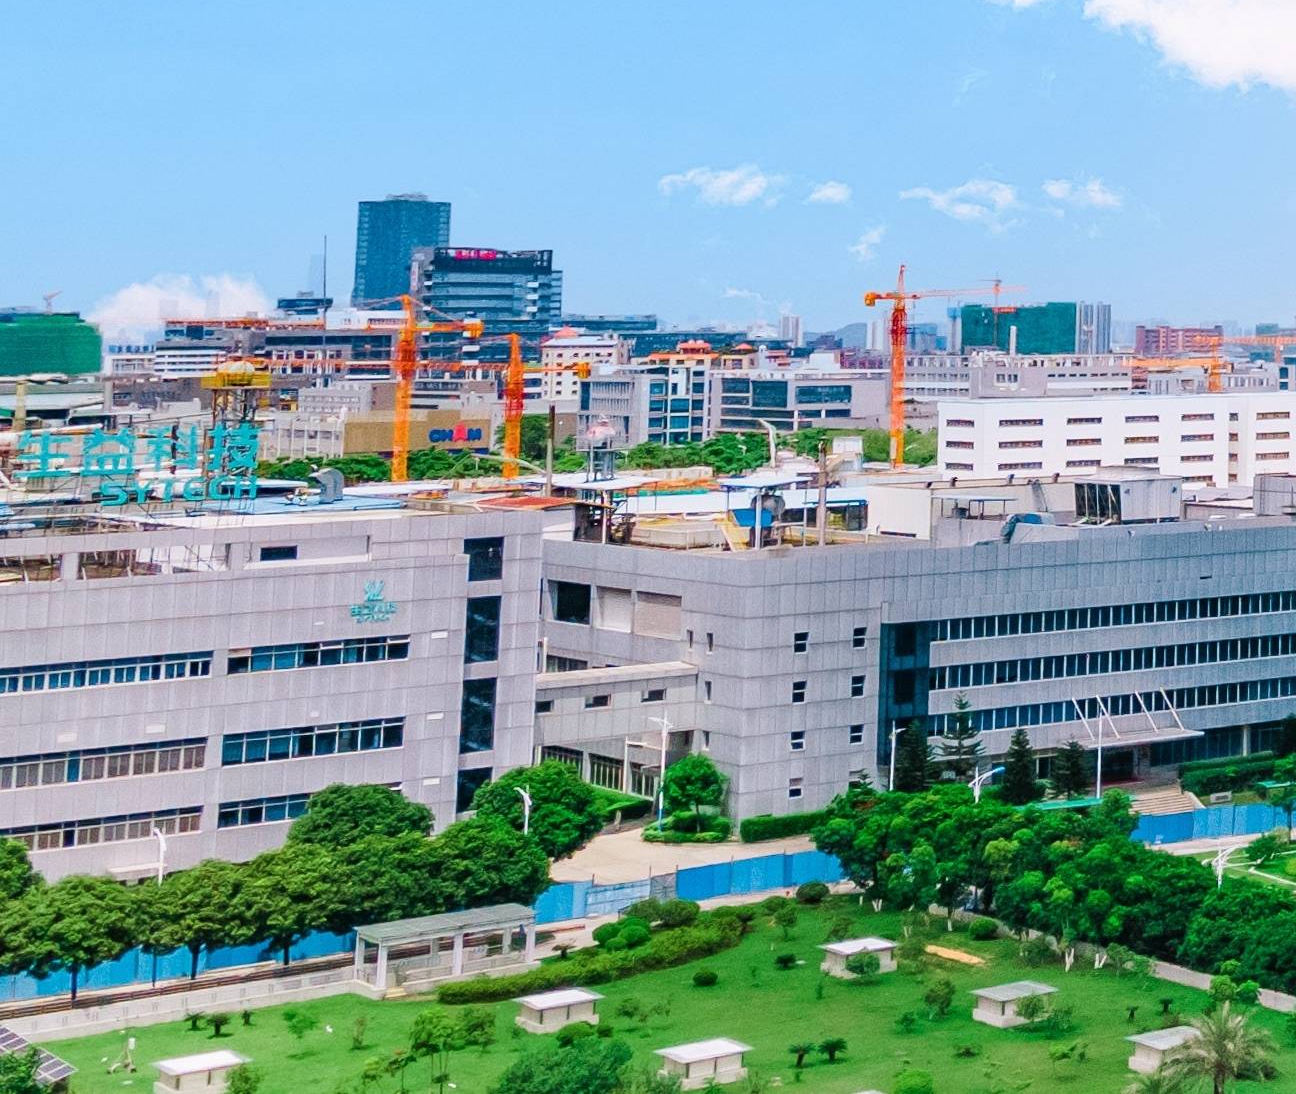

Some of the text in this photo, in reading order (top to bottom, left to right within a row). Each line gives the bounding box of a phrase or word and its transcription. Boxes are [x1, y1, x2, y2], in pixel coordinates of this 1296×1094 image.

[12, 421, 262, 479] 生益科技
[99, 475, 258, 507] SYTECH
